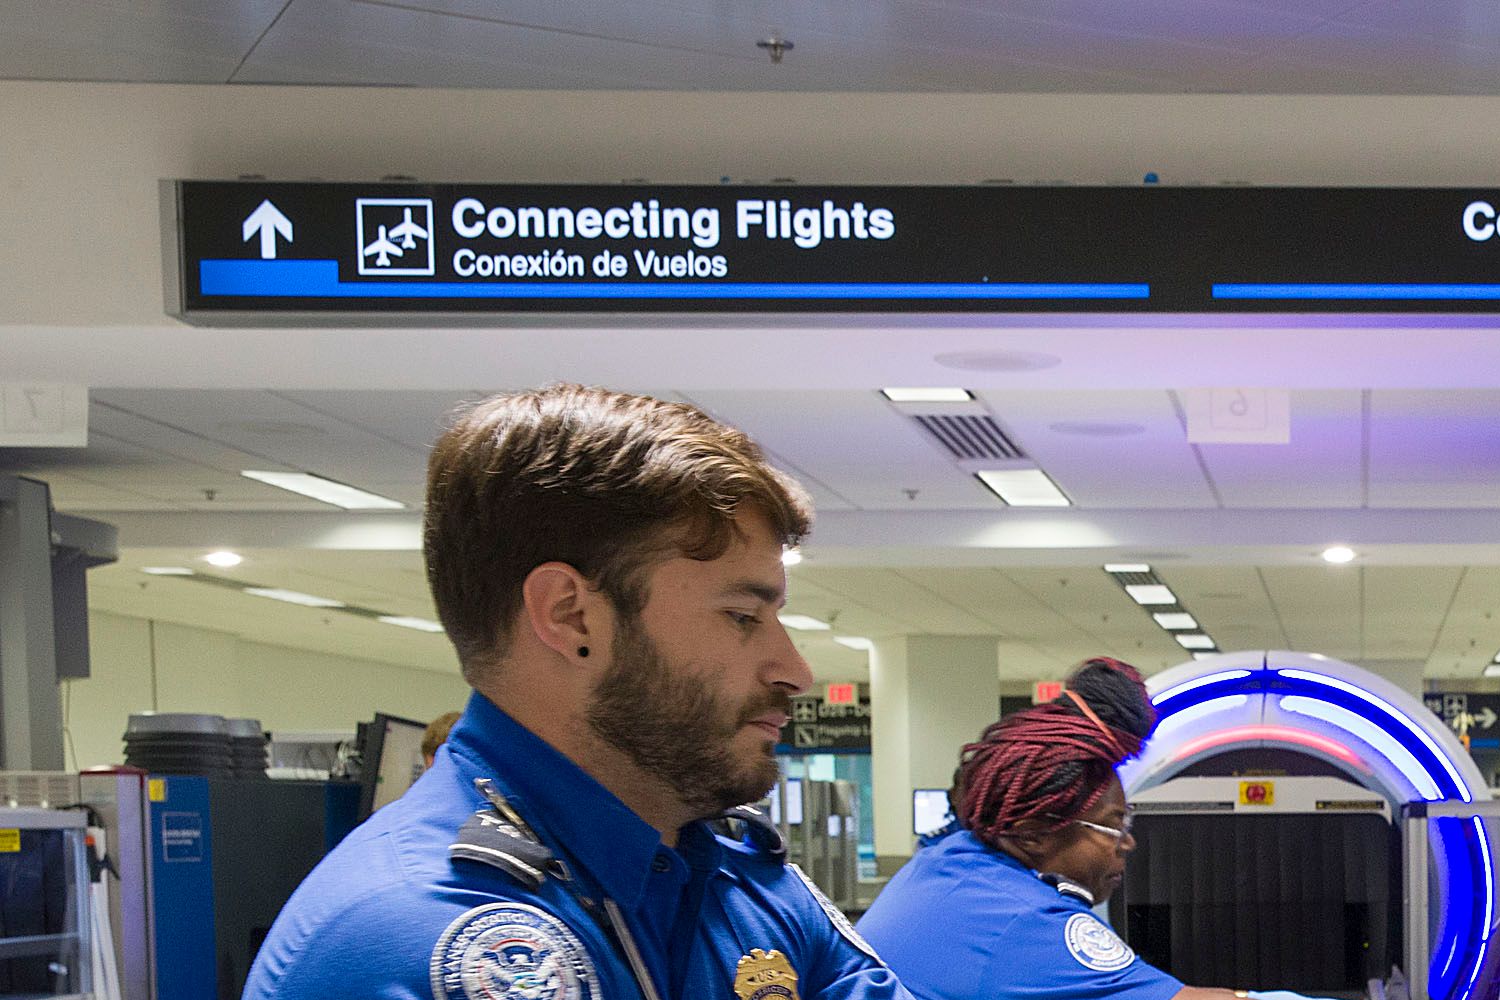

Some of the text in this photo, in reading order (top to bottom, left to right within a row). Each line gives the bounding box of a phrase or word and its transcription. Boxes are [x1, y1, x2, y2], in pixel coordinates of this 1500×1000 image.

[452, 198, 895, 248] Connecting Flights
[453, 248, 728, 277] Conexión de Vuelos
